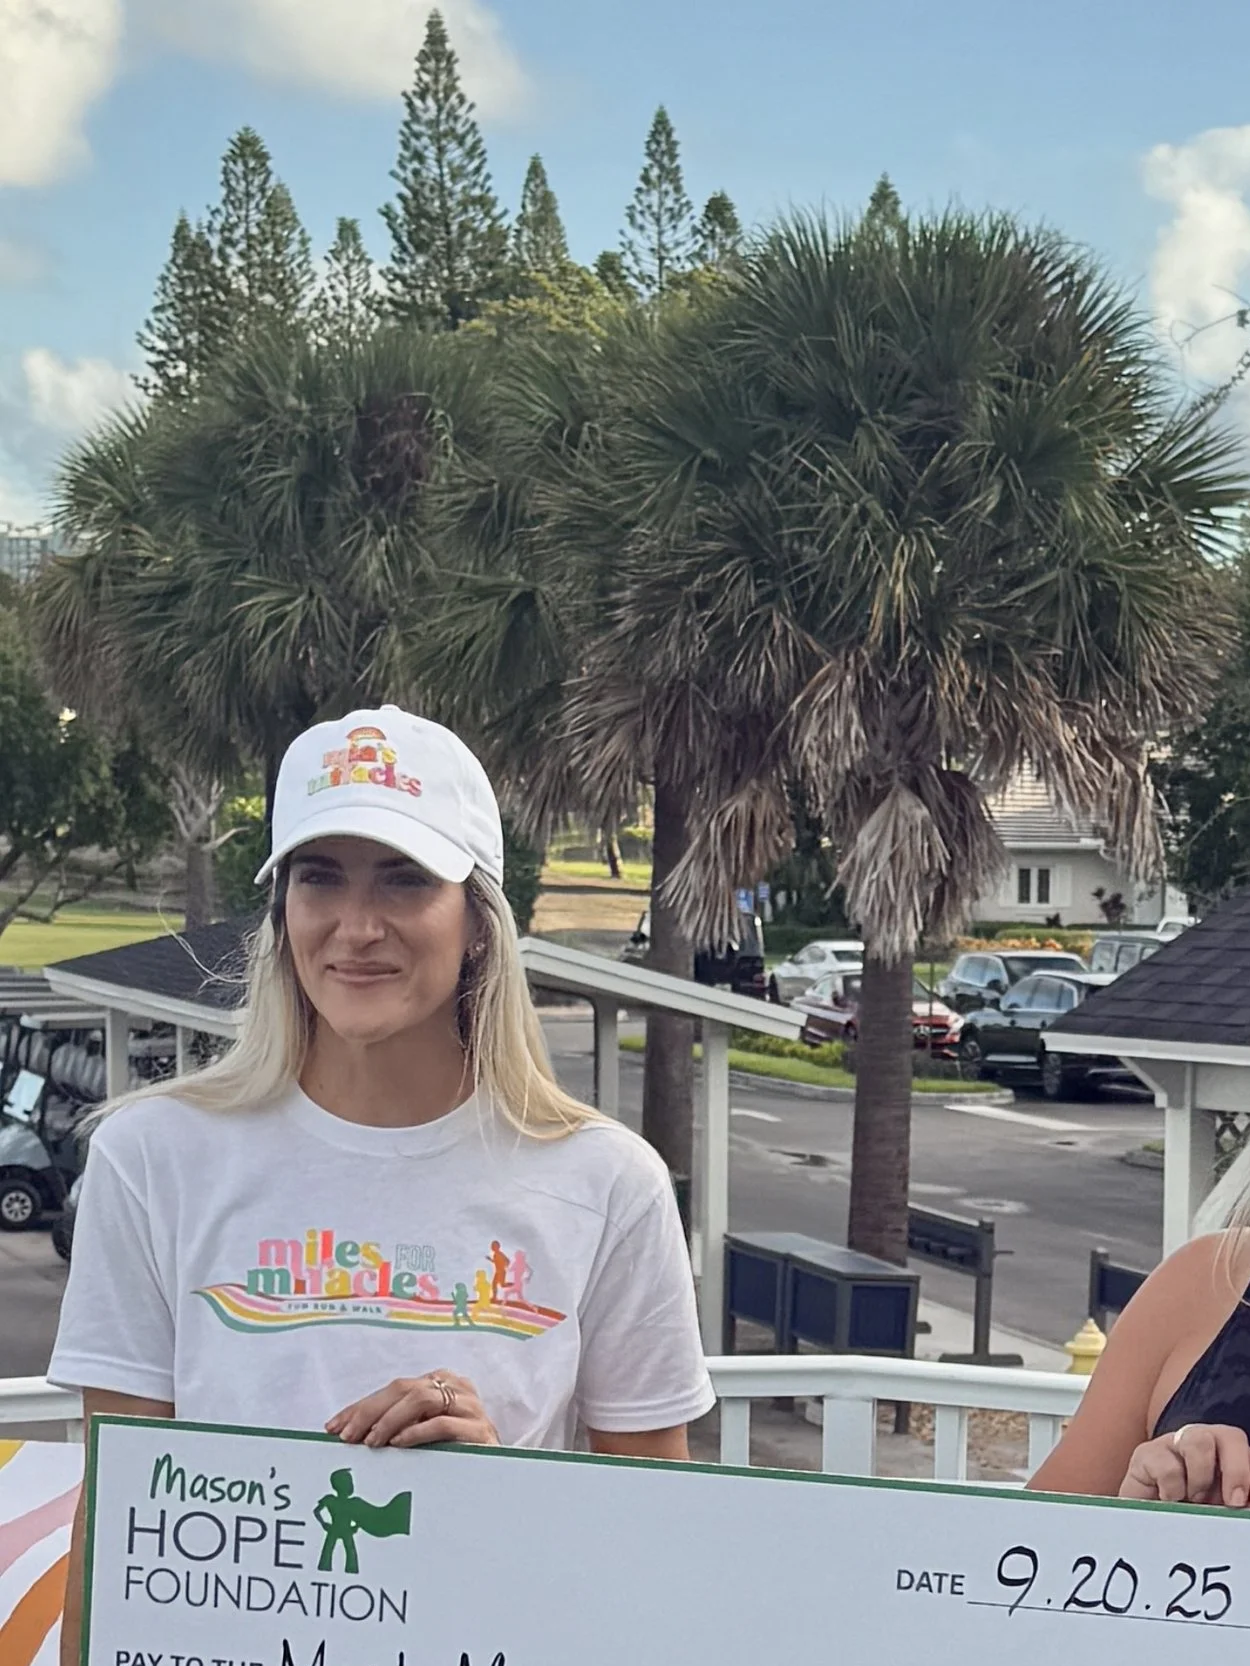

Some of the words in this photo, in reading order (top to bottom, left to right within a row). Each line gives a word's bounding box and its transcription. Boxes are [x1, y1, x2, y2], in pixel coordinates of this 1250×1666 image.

[258, 1228, 381, 1272] miles
[395, 1244, 436, 1271] FOR
[247, 1261, 441, 1300] miracles
[352, 1305, 382, 1313] WALK
[150, 1452, 292, 1511] Mason's
[127, 1506, 306, 1569] HOPE
[125, 1565, 408, 1624] FOUNDATION
[896, 1568, 965, 1596] DATE
[996, 1545, 1232, 1621] 9.20.25
